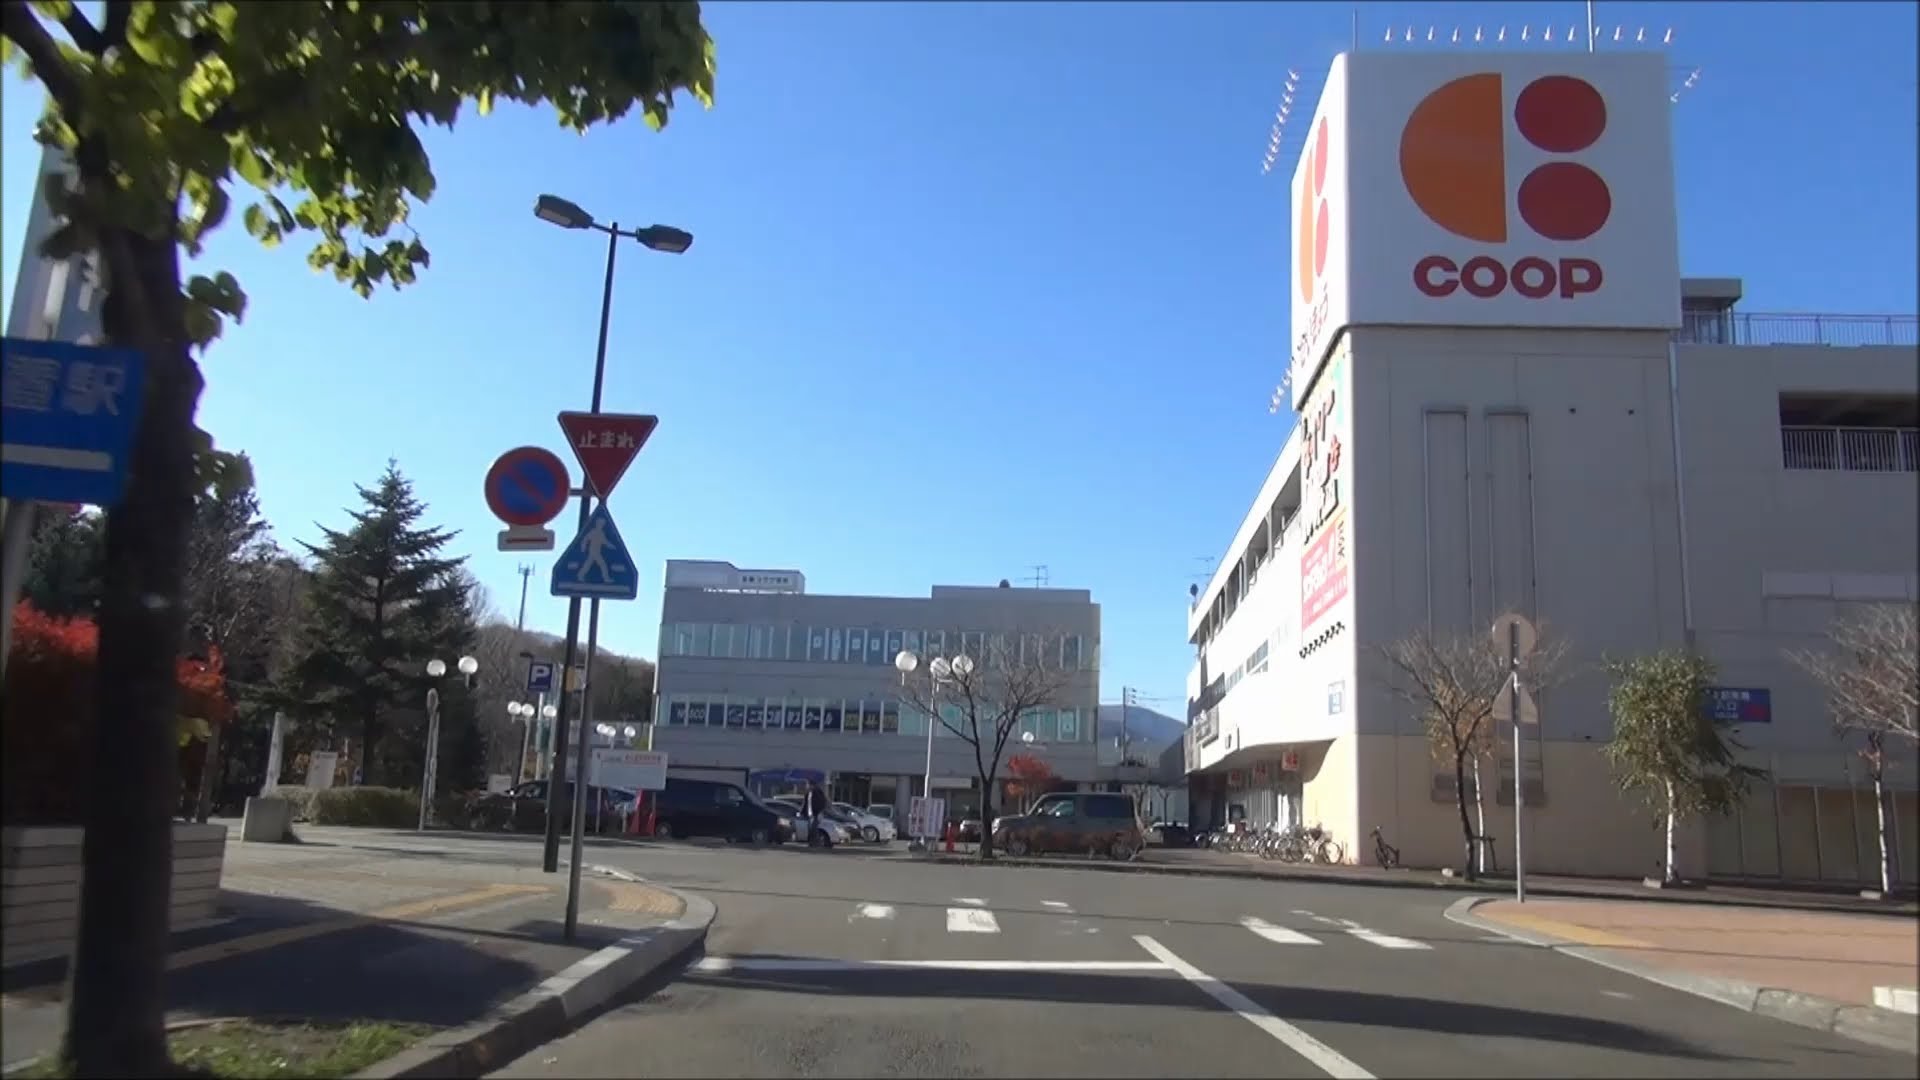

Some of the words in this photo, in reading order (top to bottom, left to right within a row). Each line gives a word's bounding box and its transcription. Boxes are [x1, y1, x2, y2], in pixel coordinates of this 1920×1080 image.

[1413, 255, 1603, 299] COOP
[579, 430, 635, 449] 止まれ
[530, 665, 550, 684] P
